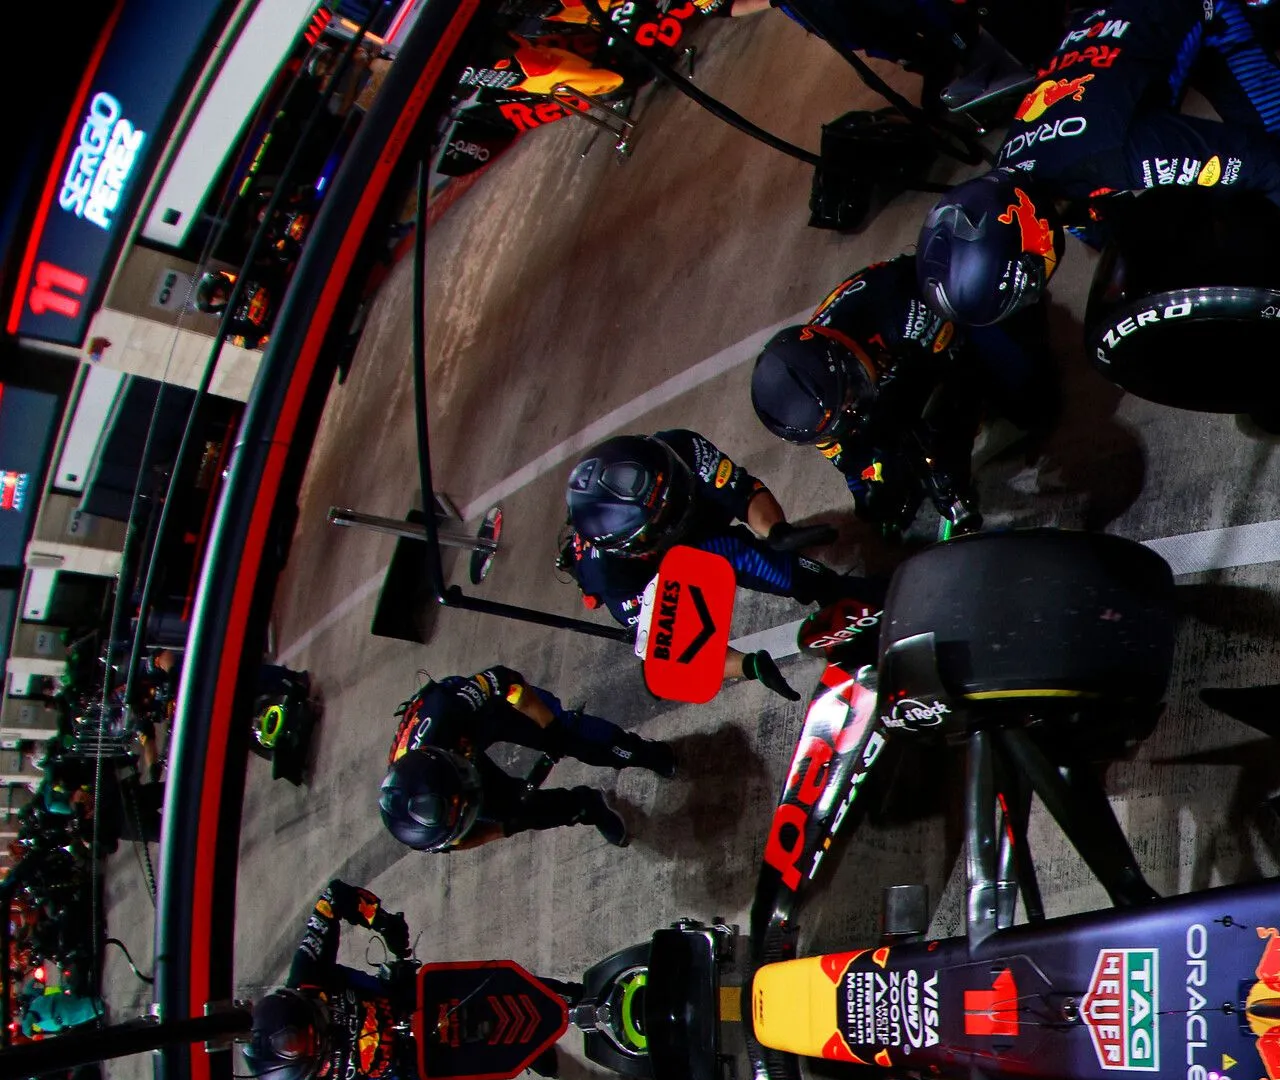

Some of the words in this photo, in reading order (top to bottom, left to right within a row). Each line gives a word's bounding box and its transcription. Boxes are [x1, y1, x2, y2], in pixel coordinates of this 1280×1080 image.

[58, 92, 121, 218] SERGIO
[84, 118, 146, 231] PEREZ
[455, 140, 490, 163] Claro
[1155, 158, 1169, 185] OKT
[29, 260, 88, 318] 11
[1097, 347, 1111, 364] P
[1102, 303, 1192, 349] ZERO
[654, 580, 680, 660] BRAKES
[808, 608, 884, 650] Claro
[913, 700, 952, 721] Rock
[847, 972, 857, 1024] Mobil
[889, 971, 901, 1046] zoom
[923, 969, 940, 1048] VISA
[1089, 956, 1121, 1062] HEUER
[1131, 958, 1151, 1060] TAG
[344, 987, 359, 1080] ORACLE
